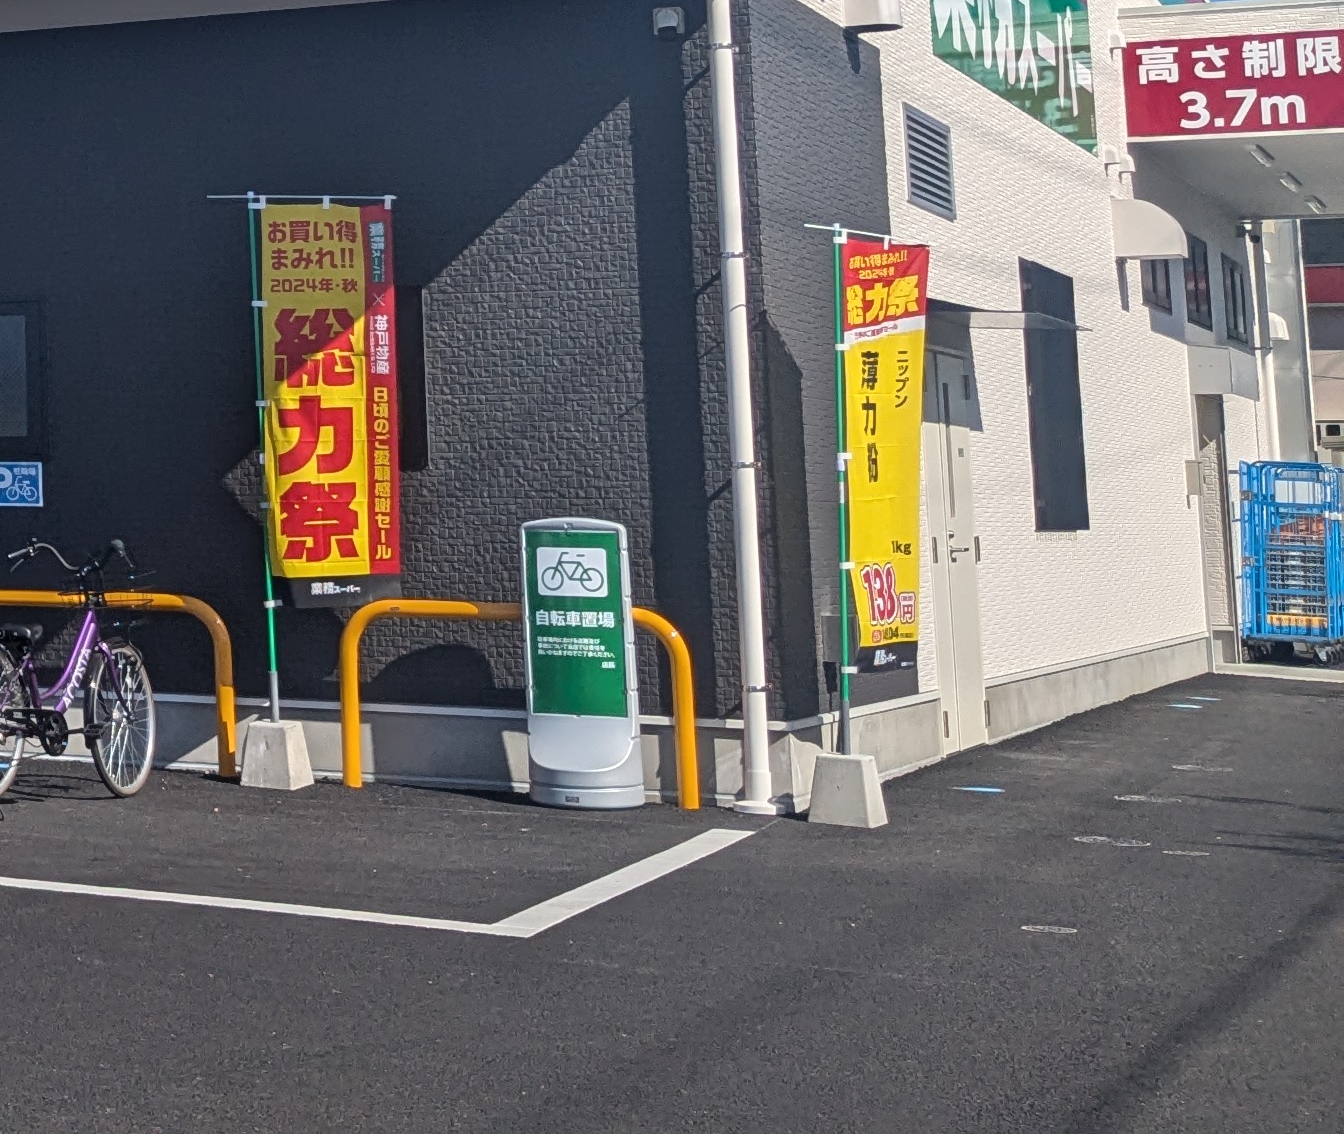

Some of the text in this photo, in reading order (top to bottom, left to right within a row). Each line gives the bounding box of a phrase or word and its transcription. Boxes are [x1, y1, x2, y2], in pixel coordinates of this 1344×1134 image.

[1136, 36, 1342, 85] 高さ制限
[1179, 89, 1306, 129] 3.7m
[267, 219, 357, 244] お買い得
[270, 247, 355, 270] まみれ!!
[846, 275, 919, 326] 総力祭
[375, 314, 390, 374] 神戸物産
[895, 351, 909, 408] ニップン
[274, 308, 360, 563] 総力祭
[861, 351, 879, 483] 薄力粉
[373, 386, 391, 560] 日頃のご愛顧感謝セール
[891, 540, 912, 555] 1kg
[535, 609, 615, 628] 自転車置場
